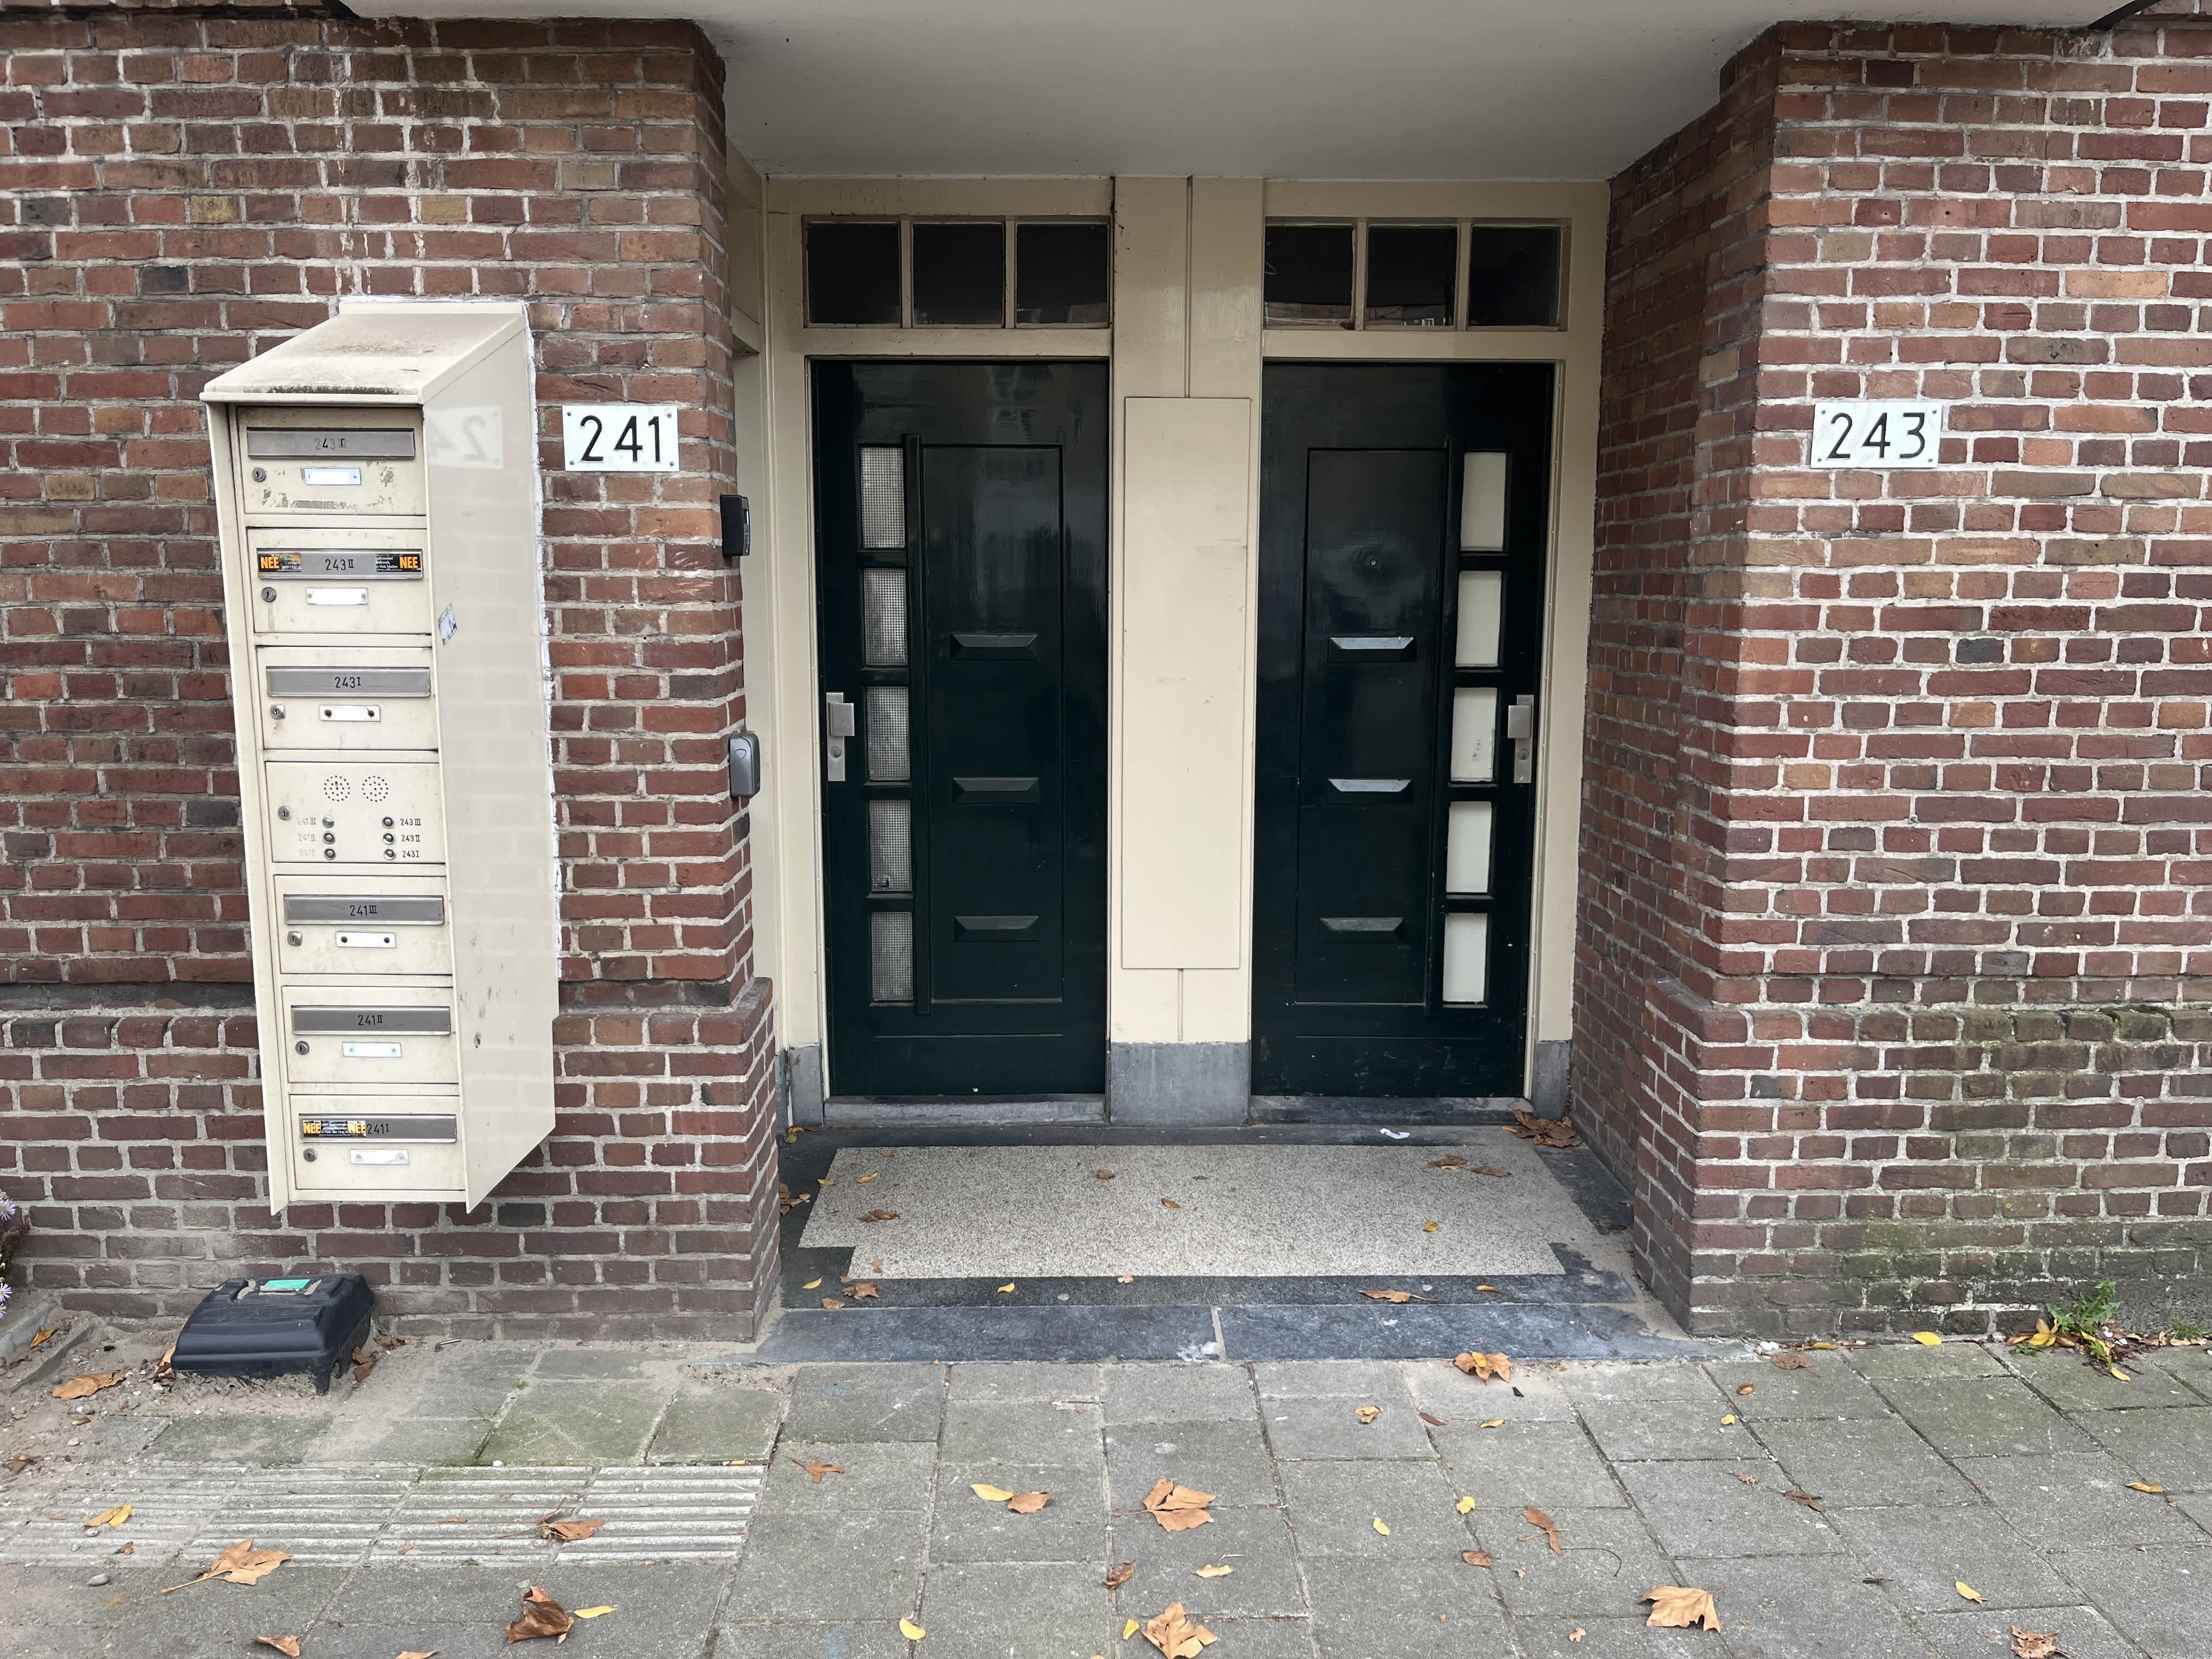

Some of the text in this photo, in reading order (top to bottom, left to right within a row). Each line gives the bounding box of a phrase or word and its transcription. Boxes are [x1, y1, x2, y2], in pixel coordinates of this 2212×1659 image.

[579, 415, 662, 462] 241
[1827, 412, 1926, 459] 243
[260, 556, 280, 569] NEE
[399, 556, 419, 569] NEE
[303, 1122, 321, 1134] NEE
